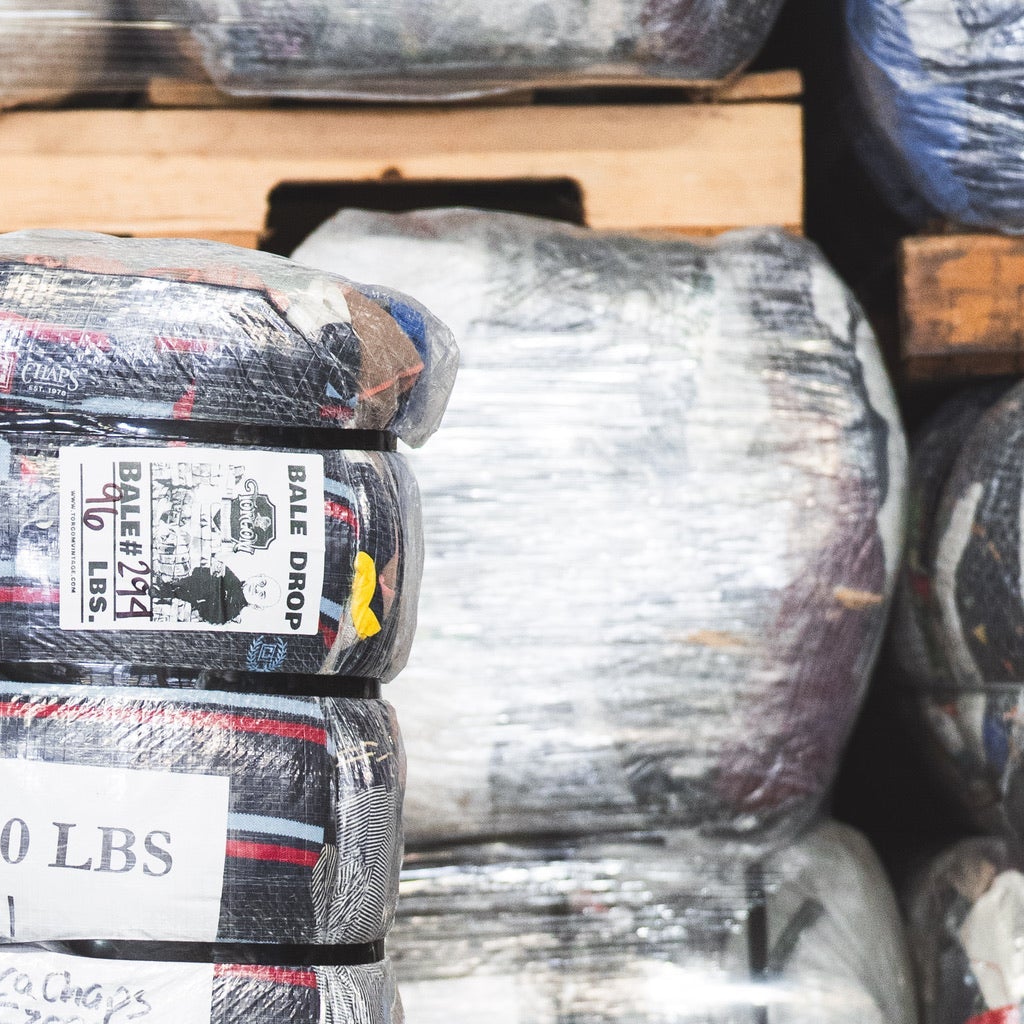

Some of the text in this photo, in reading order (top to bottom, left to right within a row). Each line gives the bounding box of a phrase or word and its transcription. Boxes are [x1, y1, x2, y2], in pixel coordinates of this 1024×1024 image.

[21, 362, 79, 391] CHAPS
[28, 385, 45, 393] EST.
[233, 478, 259, 556] TORGOM
[83, 482, 124, 623] 96 LBS.
[284, 465, 308, 631] BALE DROP
[115, 560, 154, 619] 294
[48, 822, 174, 877] LBS
[42, 971, 152, 1022] Chaps
